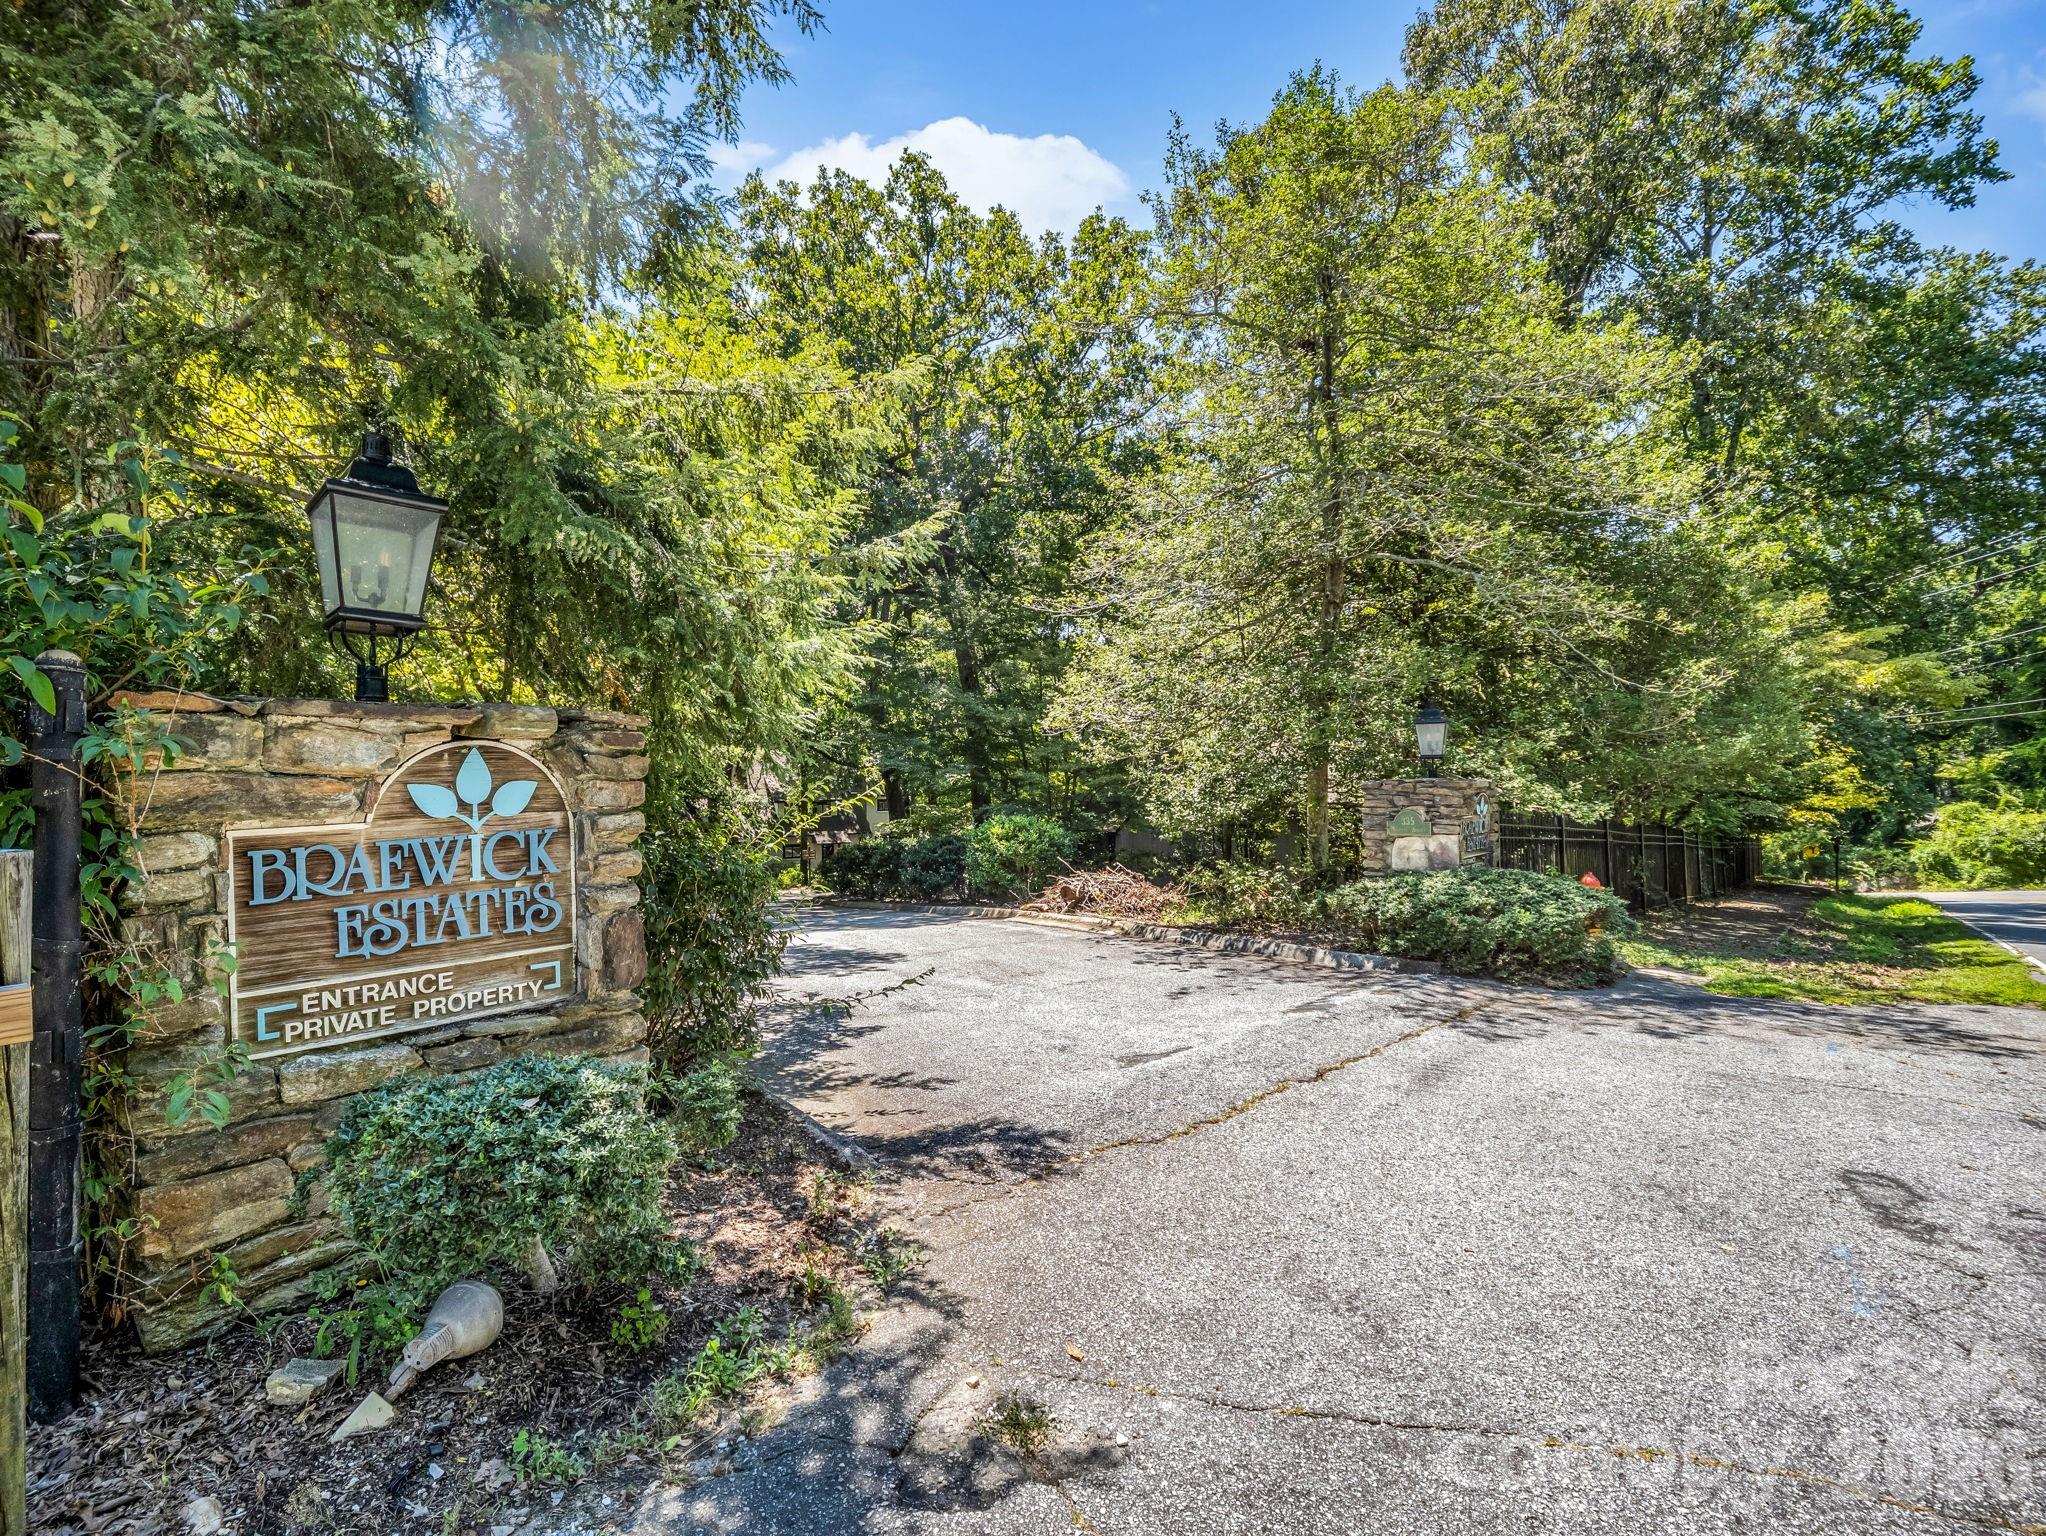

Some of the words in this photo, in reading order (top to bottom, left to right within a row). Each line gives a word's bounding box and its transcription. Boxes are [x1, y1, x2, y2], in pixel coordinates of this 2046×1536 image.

[247, 827, 561, 906] BRAEWICK
[333, 881, 564, 960] ESTATES
[284, 1007, 396, 1043] PRIVATE
[413, 979, 544, 1020] PROPERTY
[302, 972, 454, 1014] ENTRANCE
